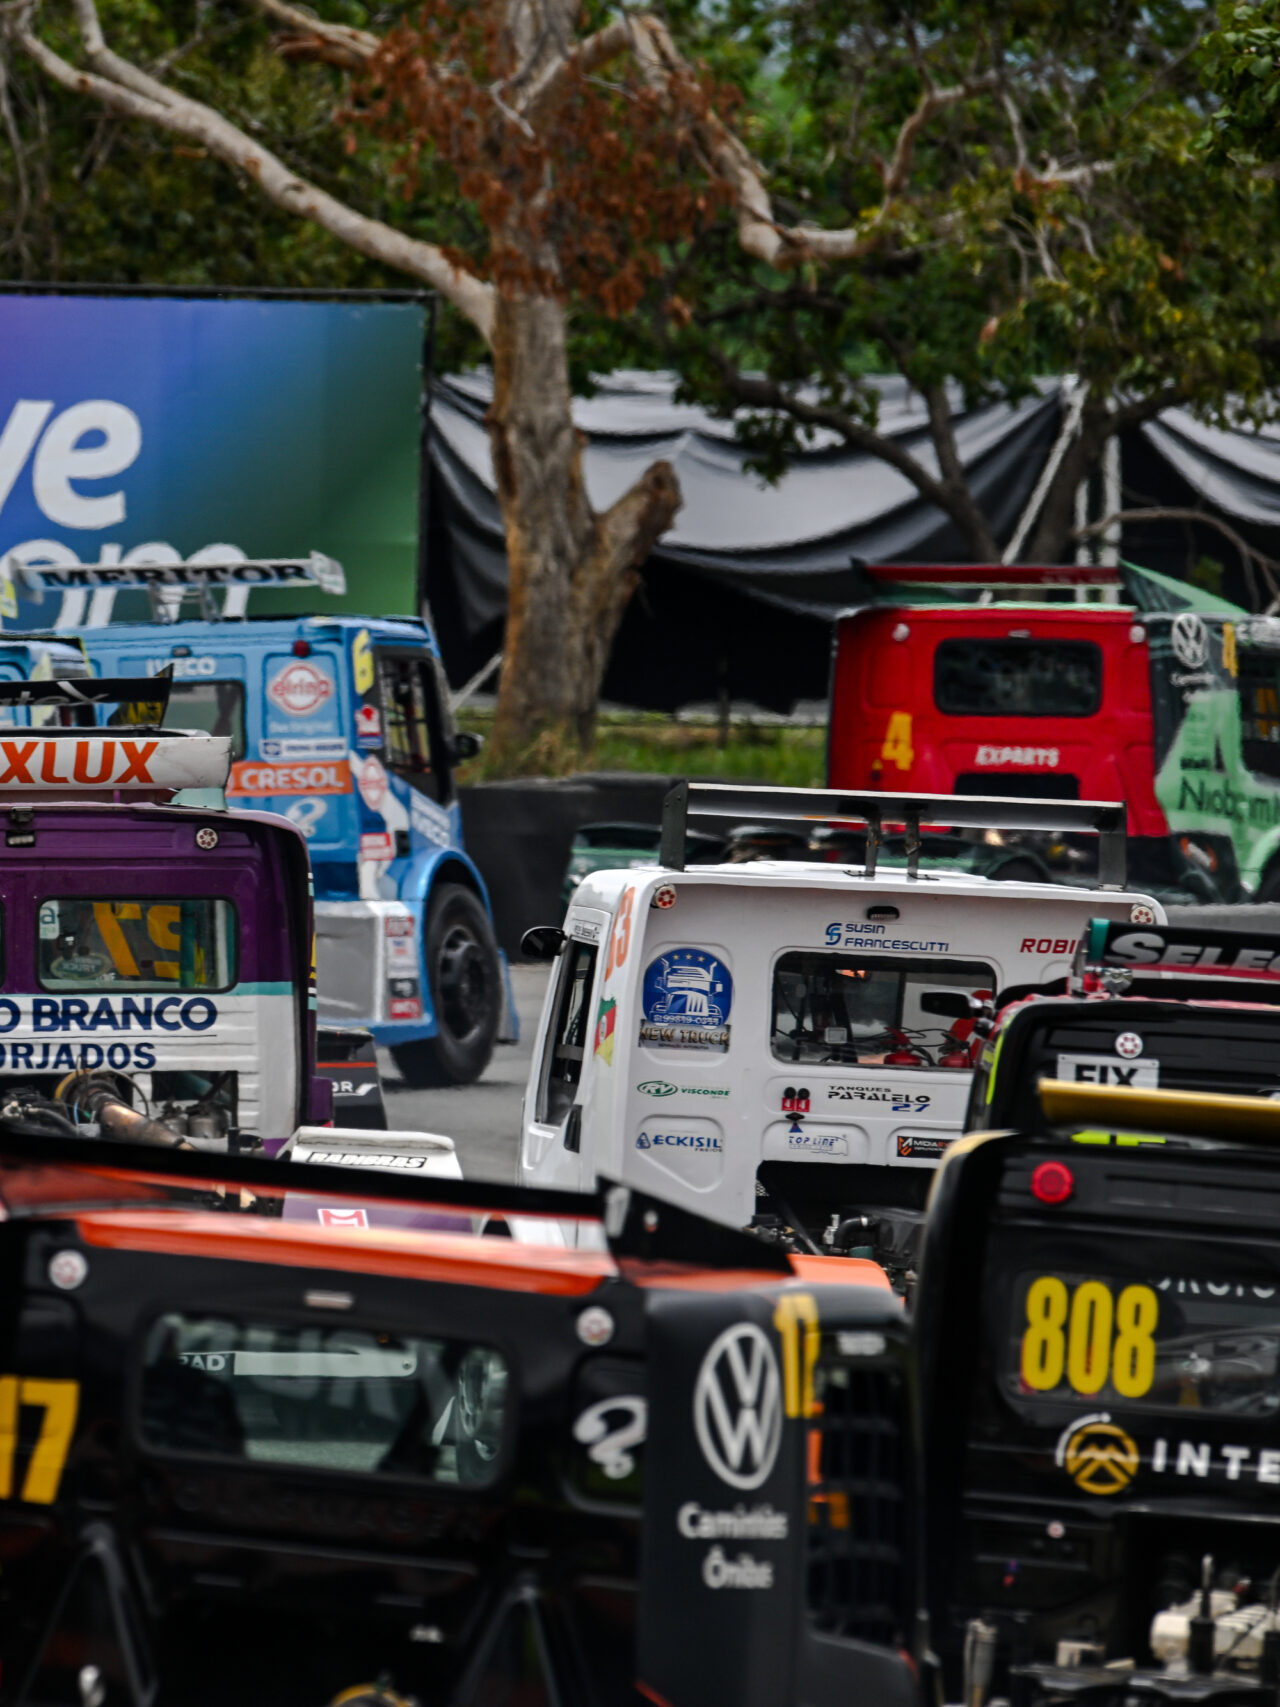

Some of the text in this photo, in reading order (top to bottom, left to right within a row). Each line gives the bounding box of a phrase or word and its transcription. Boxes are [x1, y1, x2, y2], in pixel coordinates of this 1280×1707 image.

[39, 562, 312, 588] MERITOR
[882, 711, 914, 771] 4
[240, 766, 345, 791] CRESOL
[844, 923, 886, 935] SUSIN
[844, 937, 950, 952] FRANCESCUTTI
[32, 996, 218, 1032] BRANCO
[680, 1029, 729, 1046] TRUCK
[681, 1088, 731, 1097] VISCONDE
[828, 1085, 892, 1093] TANQUES
[827, 1091, 931, 1104] PARALELO
[891, 1103, 931, 1112] 27
[653, 1135, 722, 1149] ECKISIL
[1021, 1275, 1159, 1398] 808
